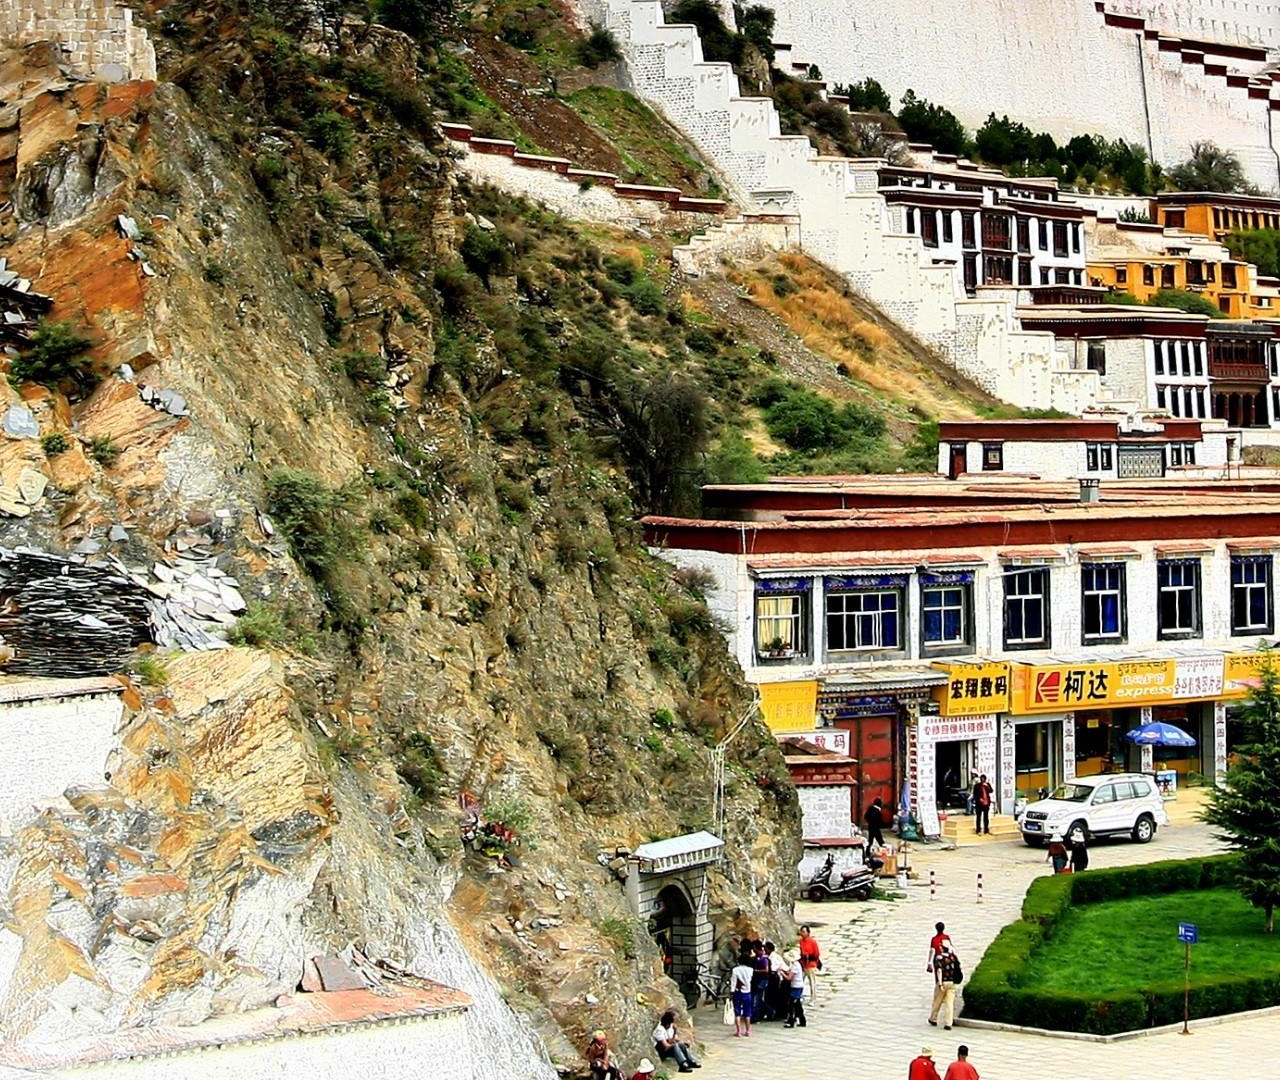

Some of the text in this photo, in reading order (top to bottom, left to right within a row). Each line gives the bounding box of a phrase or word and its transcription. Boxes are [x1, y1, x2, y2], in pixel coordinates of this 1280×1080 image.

[951, 676, 1007, 699] 宏翔数码
[1063, 670, 1109, 702] 柯达
[1115, 685, 1173, 698] express
[1002, 719, 1014, 799] 大型团体合影
